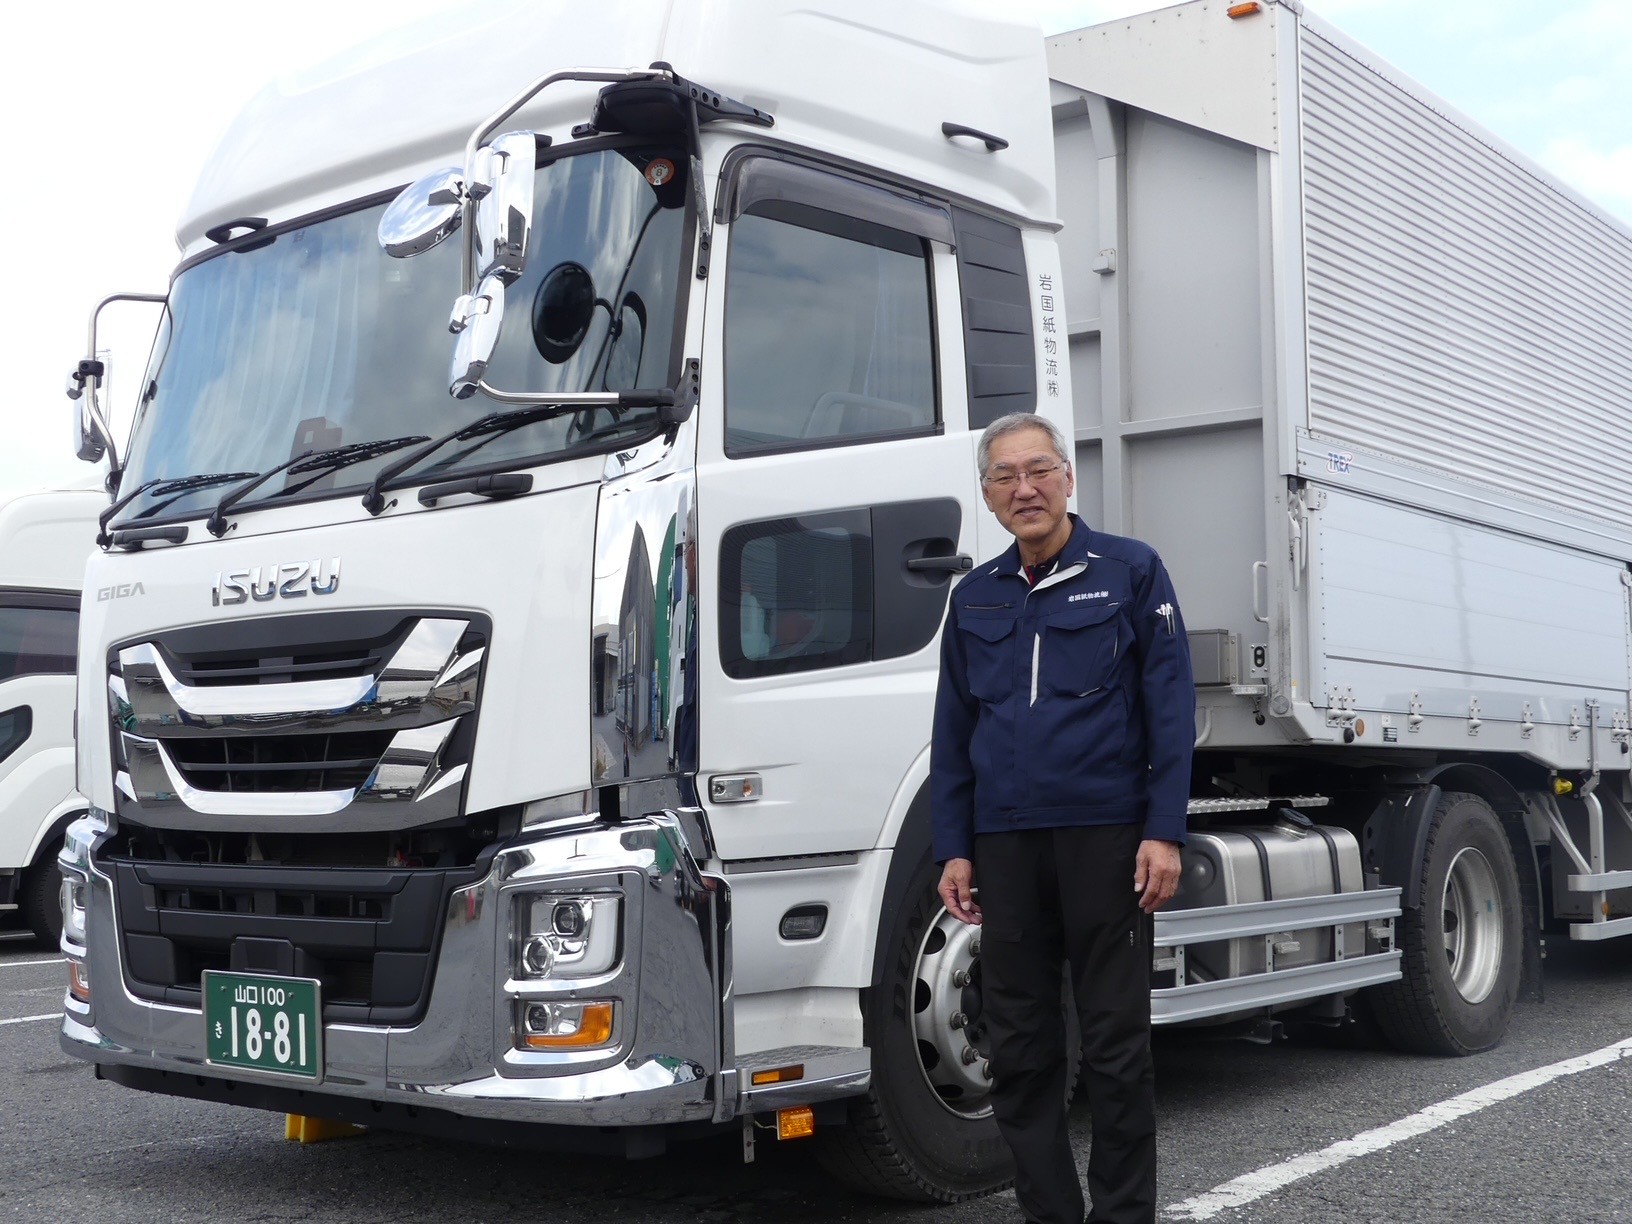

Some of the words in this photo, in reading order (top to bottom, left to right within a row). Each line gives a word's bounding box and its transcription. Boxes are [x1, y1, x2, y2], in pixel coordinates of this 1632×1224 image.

[1327, 452, 1350, 474] TREX
[97, 582, 145, 602] GIGA
[212, 556, 341, 606] ISUZU
[215, 1021, 222, 1039] き
[231, 1006, 306, 1066] 18-81
